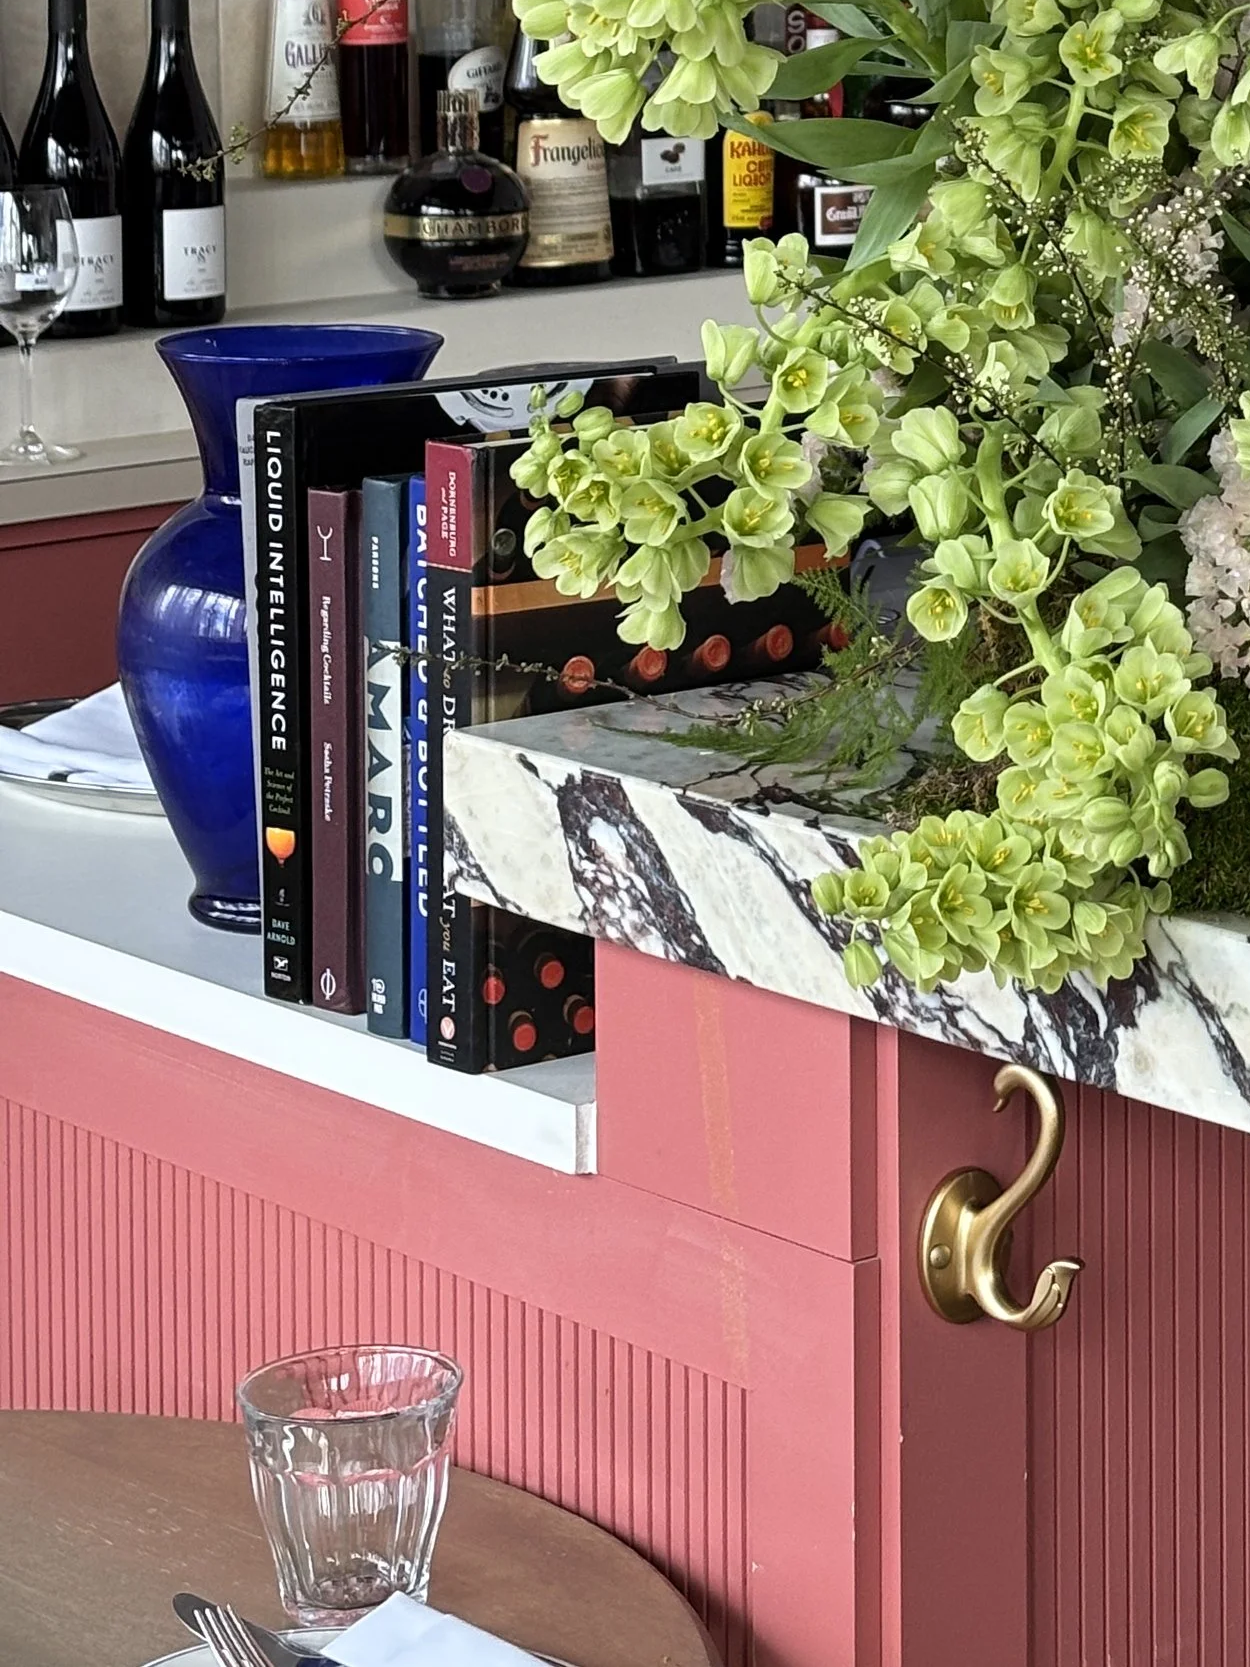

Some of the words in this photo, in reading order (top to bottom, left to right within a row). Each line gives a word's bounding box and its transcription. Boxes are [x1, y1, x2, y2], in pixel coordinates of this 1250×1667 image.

[266, 430, 283, 532] LIQUID
[268, 541, 287, 751] INTELLIGENCE
[266, 932, 296, 946] ARNOLD
[271, 918, 290, 931] DAVE
[442, 959, 456, 1013] EAT
